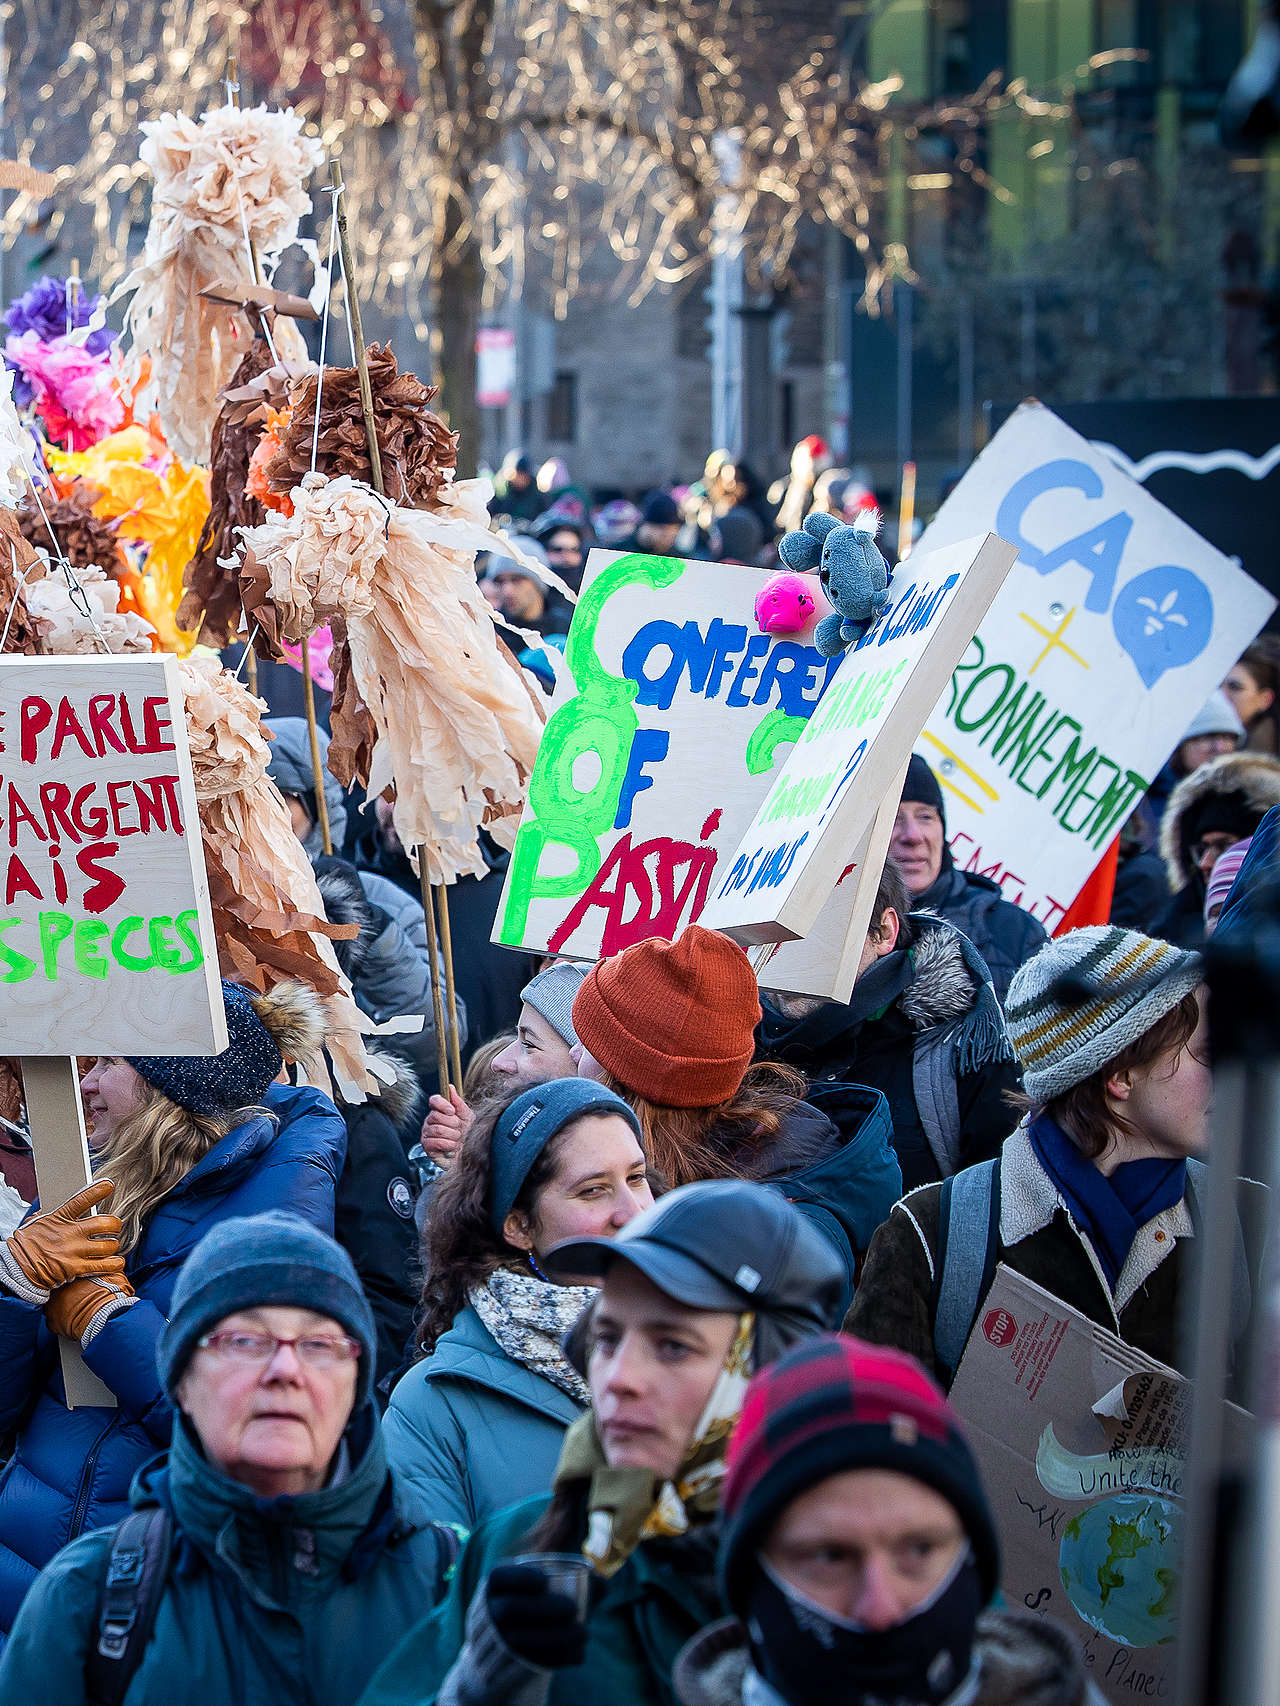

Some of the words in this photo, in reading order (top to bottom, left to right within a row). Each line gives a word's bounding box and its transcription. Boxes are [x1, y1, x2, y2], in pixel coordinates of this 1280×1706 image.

[21, 692, 176, 764] PARLE
[718, 846, 763, 899] PAS
[744, 831, 809, 898] NOUS
[989, 1312, 1009, 1344] STOP
[1079, 1461, 1138, 1494] Unite
[1150, 1463, 1183, 1494] the
